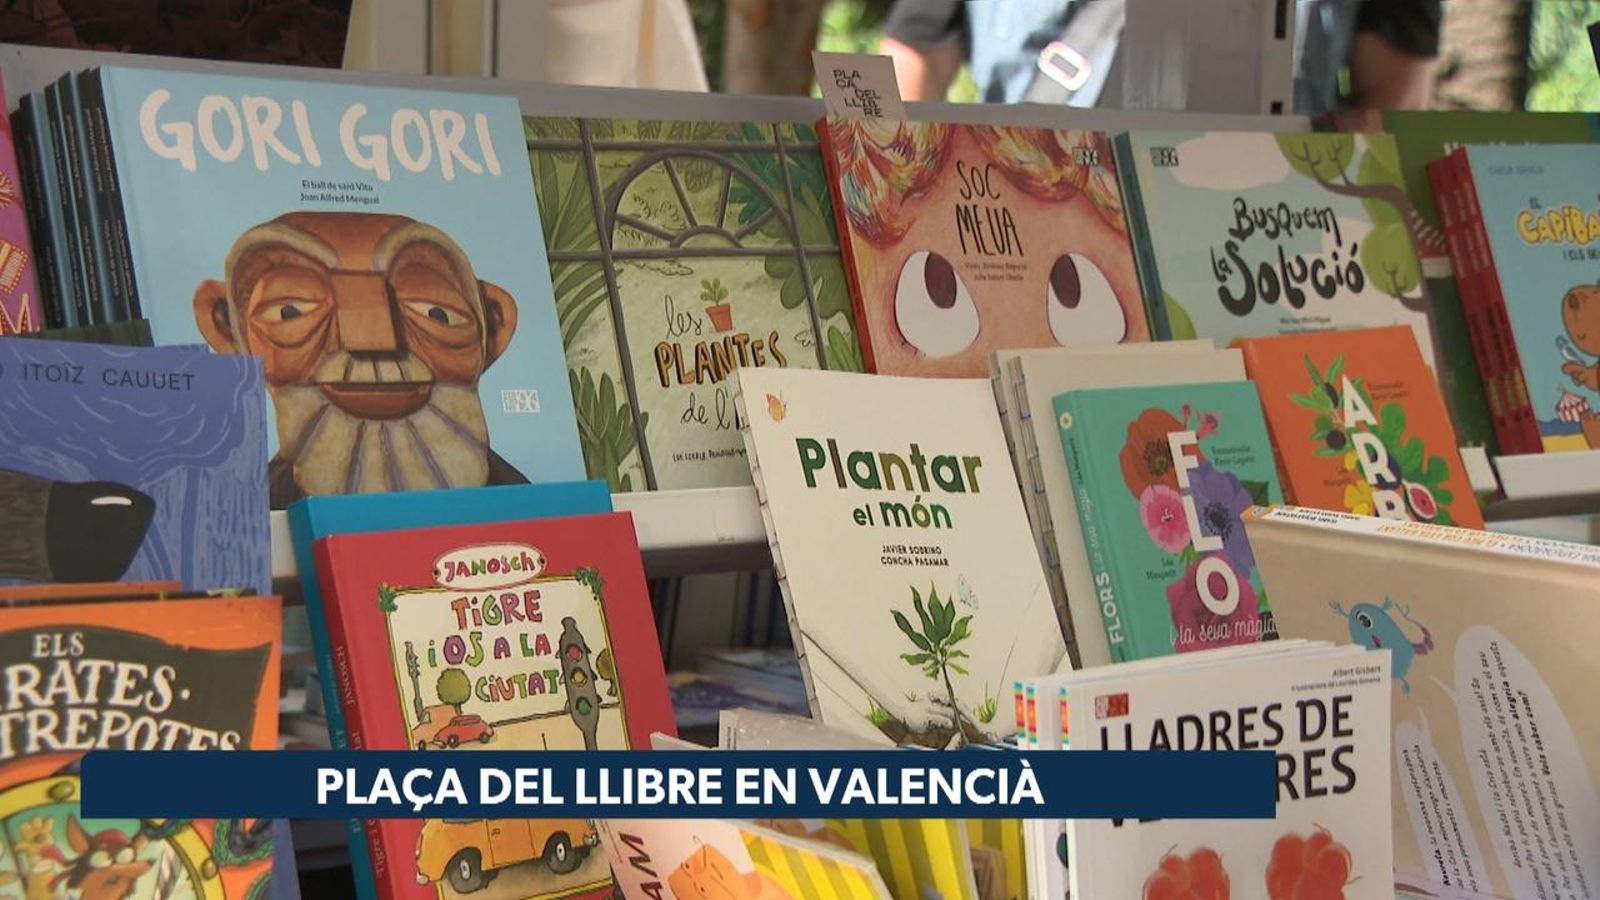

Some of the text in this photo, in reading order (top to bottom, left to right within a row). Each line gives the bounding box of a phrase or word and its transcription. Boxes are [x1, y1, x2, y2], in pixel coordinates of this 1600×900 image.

[833, 69, 861, 80] PLA
[854, 89, 881, 99] DEL
[863, 108, 884, 118] RE
[139, 89, 501, 182] GORI GORI
[302, 180, 310, 189] El
[327, 181, 337, 190] de
[956, 160, 1001, 201] SOC
[301, 193, 319, 201] Joan
[320, 193, 345, 203] Alfred
[956, 203, 1023, 256] MEUA
[1218, 240, 1364, 317] Solució
[665, 295, 702, 339] les
[654, 330, 787, 388] PLANTES
[103, 368, 194, 392] CAUUET
[681, 392, 708, 424] de
[795, 437, 982, 493] Plantar
[853, 495, 953, 529] el món
[881, 556, 949, 566] CONCHA PASAMAR
[882, 545, 942, 555] JAVIER SOBRINO
[1096, 572, 1123, 643] FLORS
[34, 632, 84, 658] ELS
[443, 632, 484, 667] OS
[494, 637, 511, 660] A
[519, 632, 551, 657] LA
[1333, 668, 1354, 677] Albert
[1503, 681, 1519, 719] alegria
[1296, 695, 1353, 742] DE
[1529, 721, 1543, 750] saber
